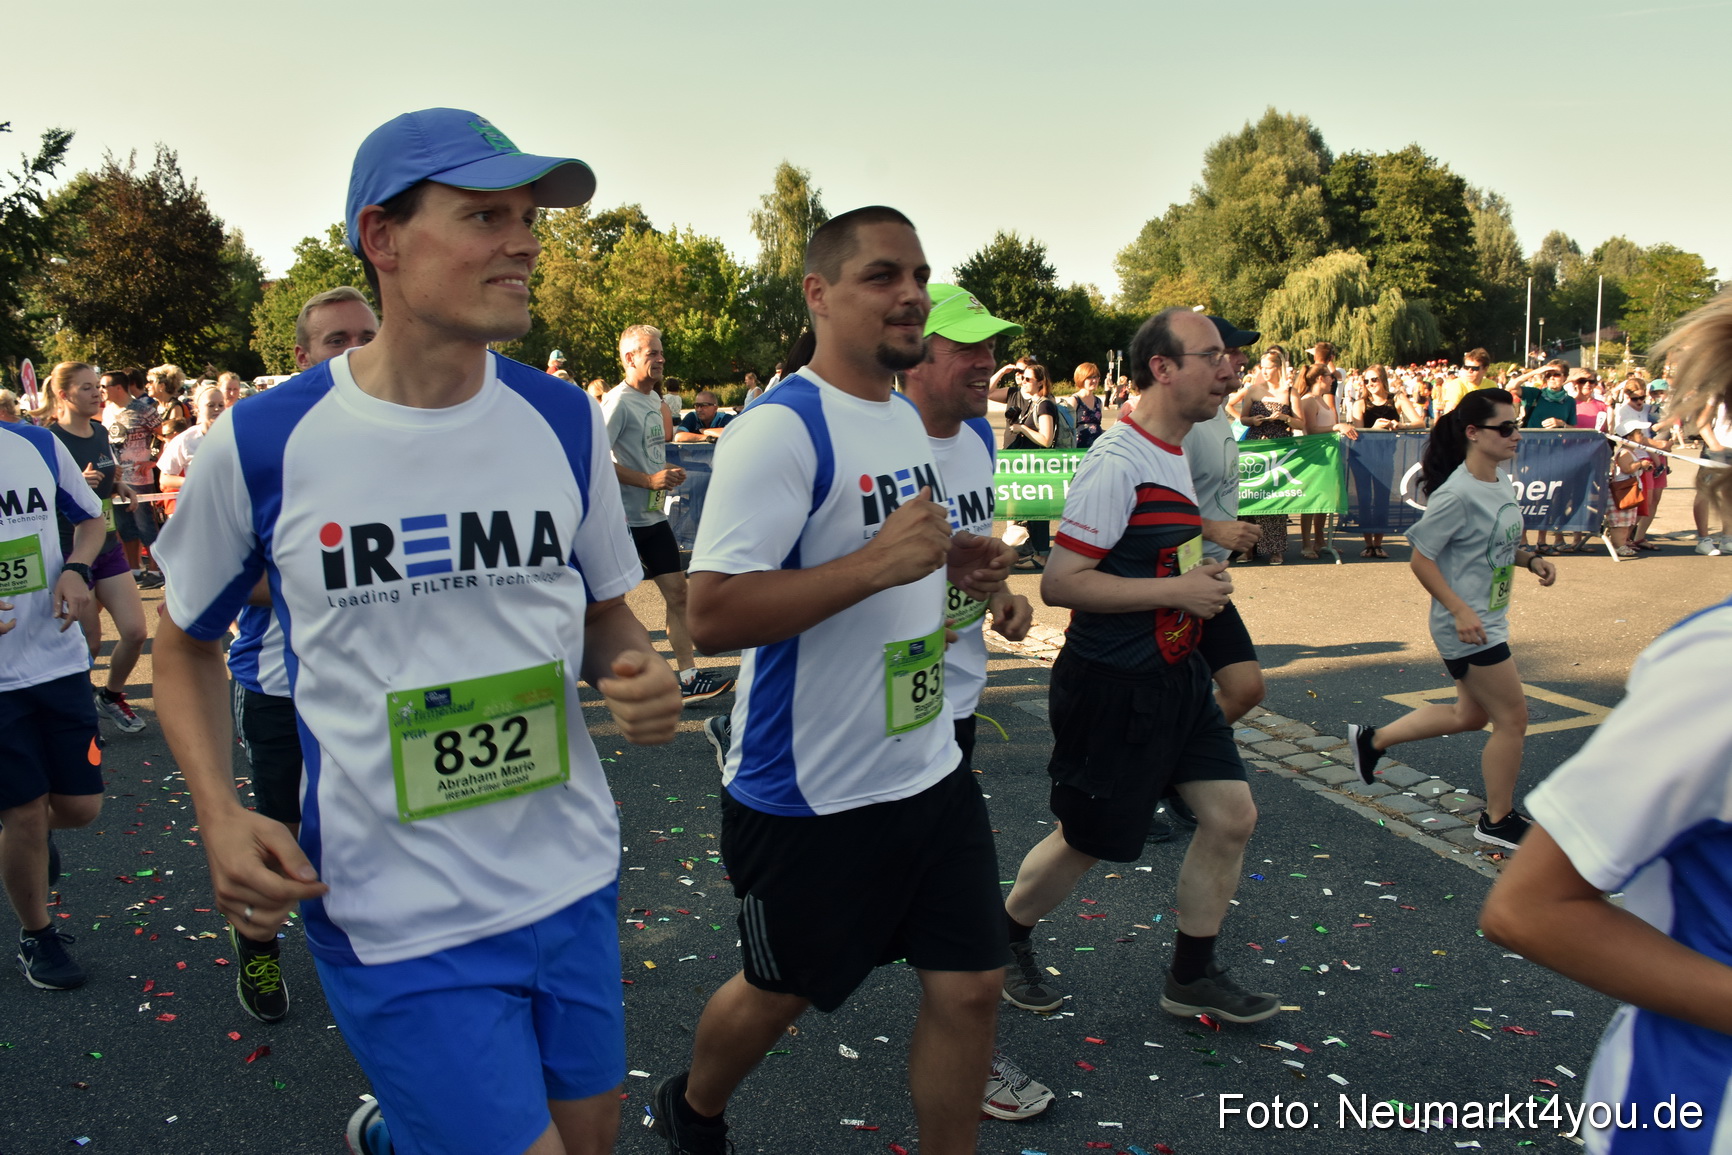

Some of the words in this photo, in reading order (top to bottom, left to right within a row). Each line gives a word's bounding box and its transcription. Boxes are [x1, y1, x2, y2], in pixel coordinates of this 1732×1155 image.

[994, 481, 1053, 500] sten
[1239, 488, 1306, 500] dheitskasse.
[7, 514, 49, 525] Technology
[0, 558, 28, 583] 35
[327, 588, 400, 609] Leading
[411, 574, 478, 596] FILTER
[434, 715, 532, 776] 832
[437, 772, 498, 792] Abraham
[501, 761, 536, 778] Mario
